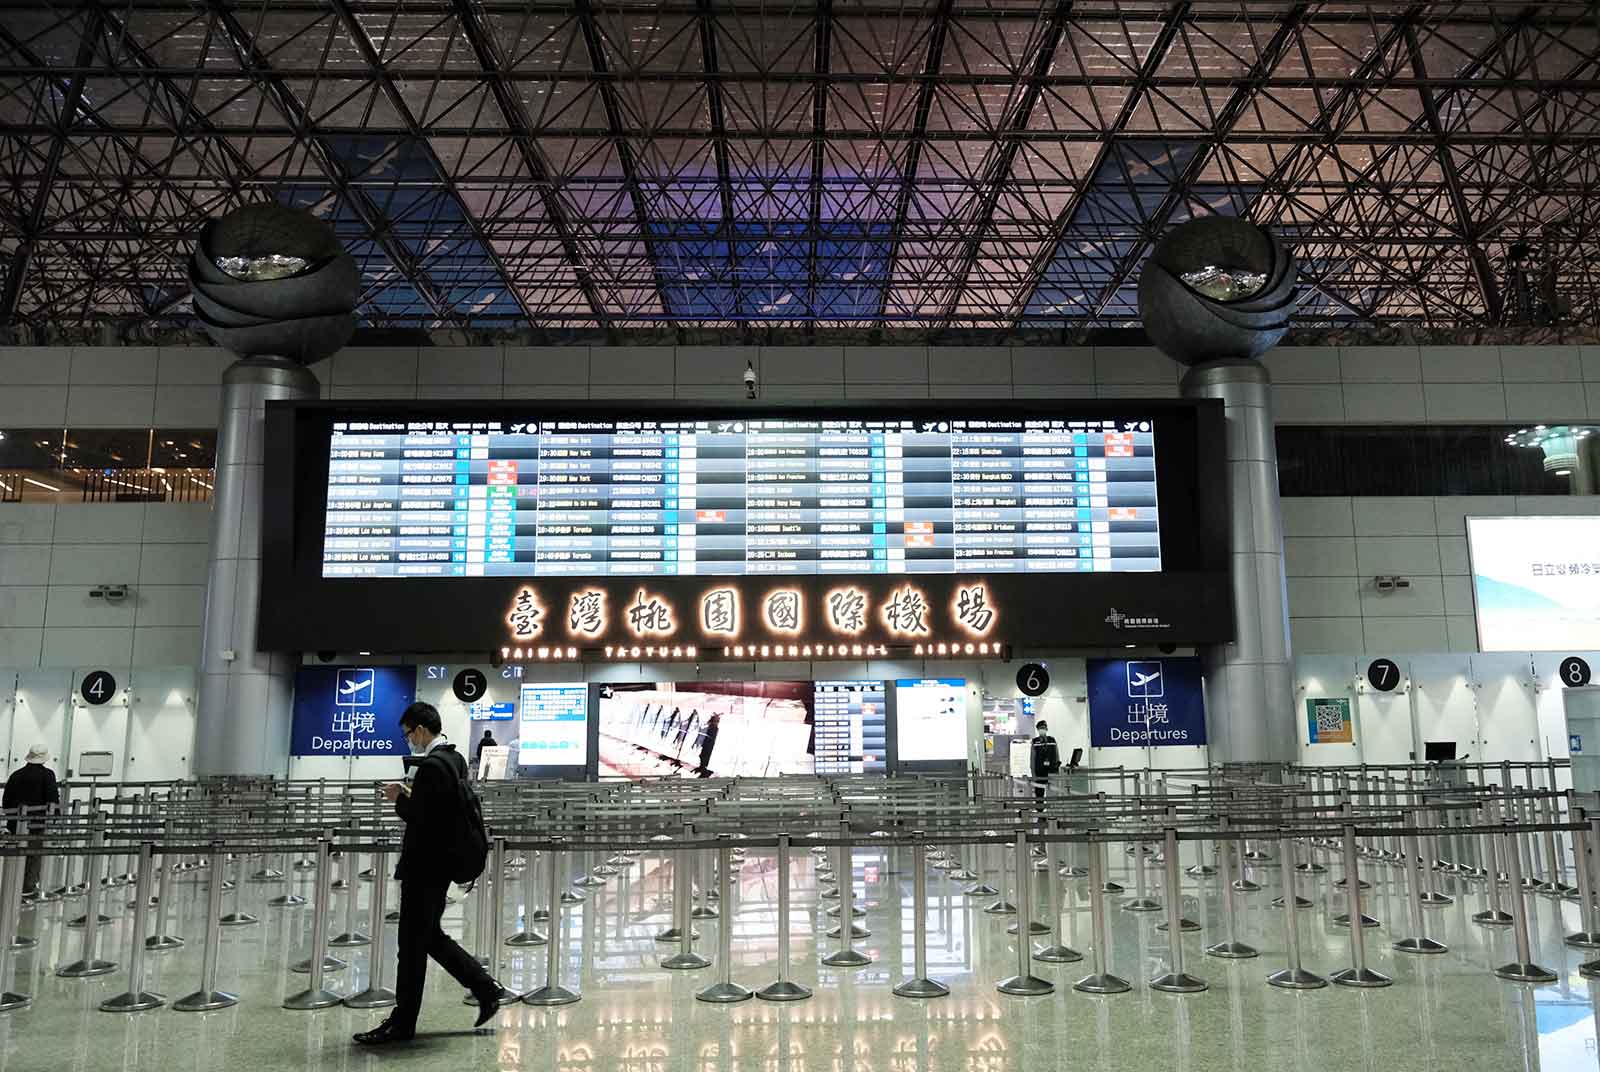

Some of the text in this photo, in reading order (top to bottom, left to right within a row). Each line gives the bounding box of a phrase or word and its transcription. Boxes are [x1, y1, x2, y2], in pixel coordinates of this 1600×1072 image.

[509, 588, 993, 635] 臺灣桃園國際機場
[501, 643, 1001, 659] TAIWAN TAOYUAN INTERNATIONAL AIRPORT
[1026, 670, 1040, 691] 6
[1377, 664, 1390, 685] 7
[1569, 662, 1583, 683] 8
[89, 677, 104, 698] 4
[463, 675, 477, 697] 5
[331, 711, 375, 733] 出境
[1127, 703, 1169, 724] 出境
[312, 735, 393, 752] Departures
[1110, 727, 1188, 743] Departures
